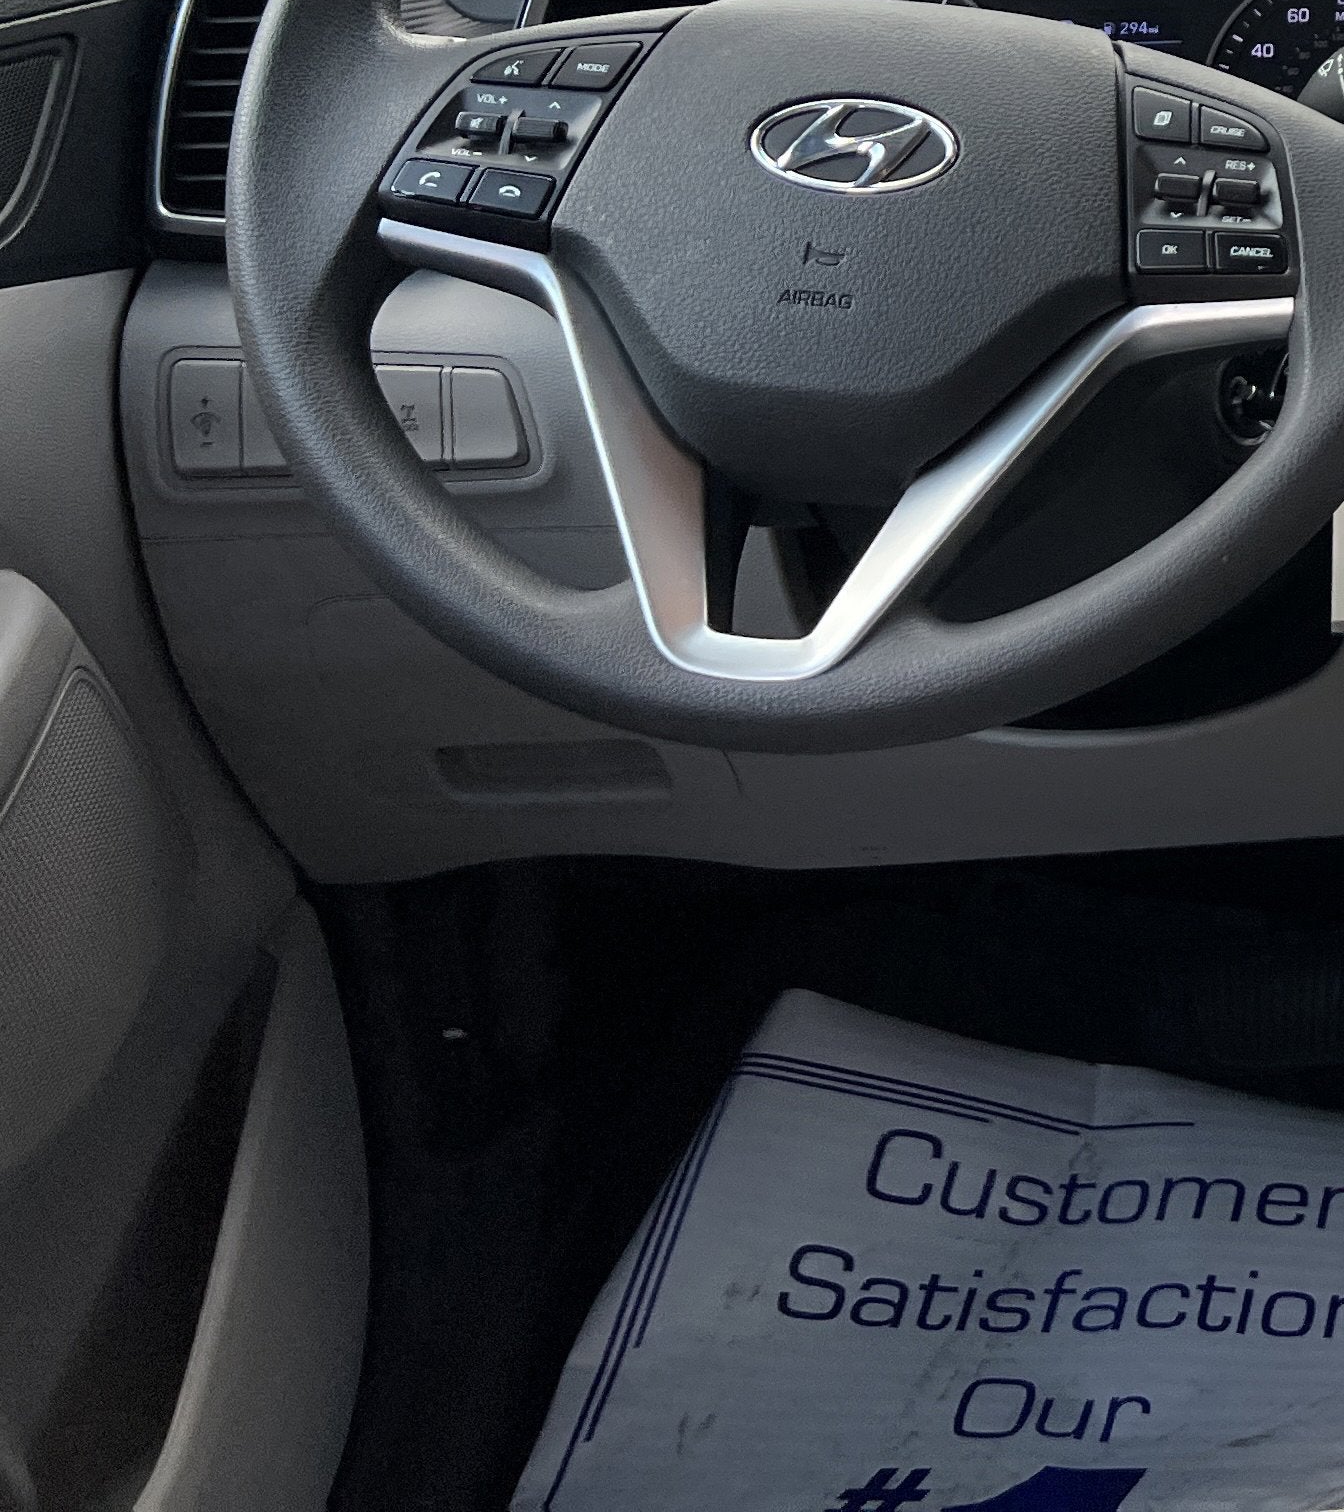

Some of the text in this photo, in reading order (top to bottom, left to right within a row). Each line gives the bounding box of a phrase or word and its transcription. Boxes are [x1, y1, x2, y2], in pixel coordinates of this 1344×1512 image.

[1287, 8, 1310, 23] 60
[1251, 44, 1274, 58] 40
[577, 62, 610, 73] MODE
[1210, 125, 1246, 137] CRUISE
[1162, 244, 1178, 255] OK
[1230, 246, 1274, 257] CANCEL
[776, 289, 853, 309] AIRBAG
[953, 1378, 1150, 1442] Our
